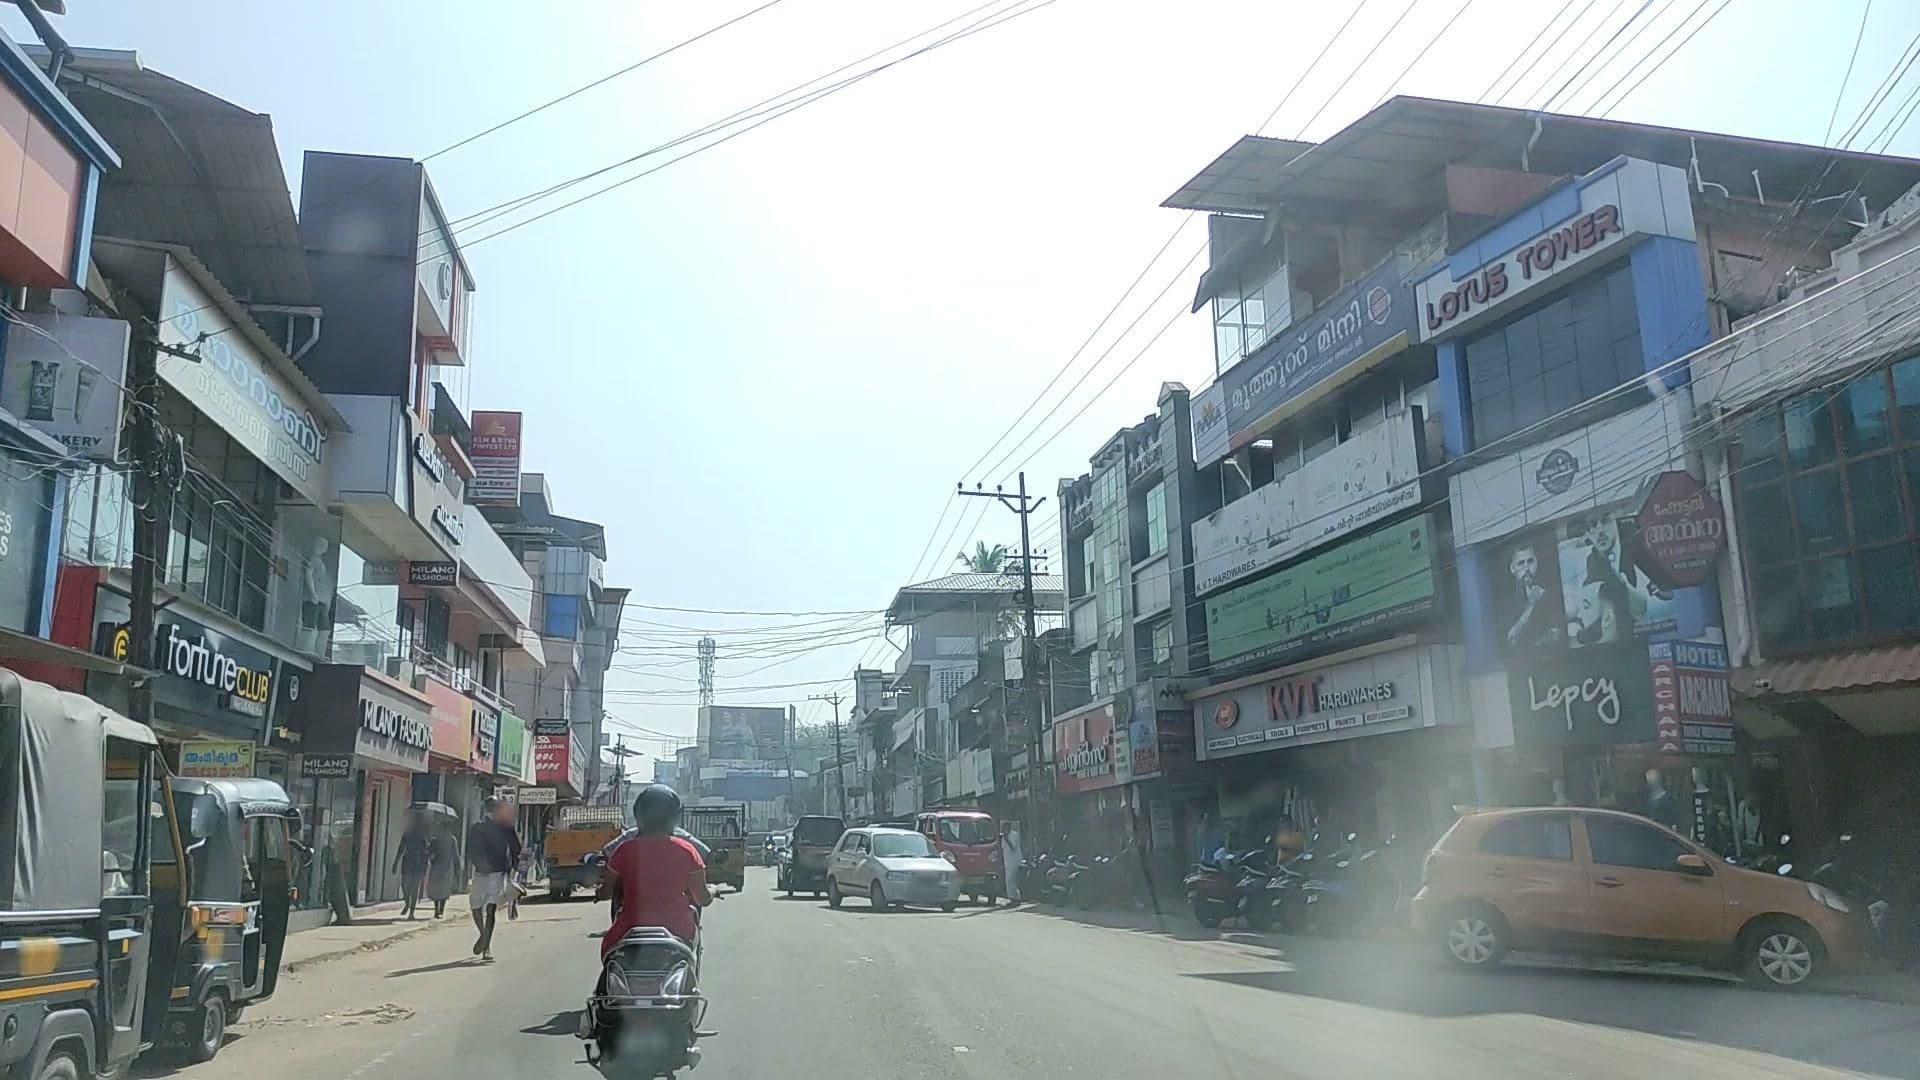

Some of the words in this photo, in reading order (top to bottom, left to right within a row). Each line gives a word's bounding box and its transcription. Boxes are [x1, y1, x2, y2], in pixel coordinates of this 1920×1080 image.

[1426, 262, 1509, 331] LOTUS
[1516, 204, 1622, 280] TOWER
[1317, 300, 1362, 352] മിനി
[52, 434, 102, 448] AKERY
[411, 565, 456, 574] MILANO
[411, 573, 454, 582] FASHIONS
[1649, 643, 1672, 658] HOTEL
[1675, 644, 1726, 667] HOTEL
[168, 624, 237, 692] fortune
[236, 667, 269, 703] CLUB
[1267, 677, 1322, 721] KVT
[1319, 682, 1392, 711] HARDWARES
[1527, 675, 1621, 731] Lepcy
[1679, 674, 1732, 718] ARCHANA
[363, 702, 398, 738] MILANO
[400, 716, 434, 751] FASHIONS
[1270, 728, 1289, 738] TOOLS
[1335, 716, 1357, 727] PAINTS
[303, 758, 349, 768] MILANO
[536, 753, 554, 761] OOL
[303, 767, 348, 776] FASHIONS
